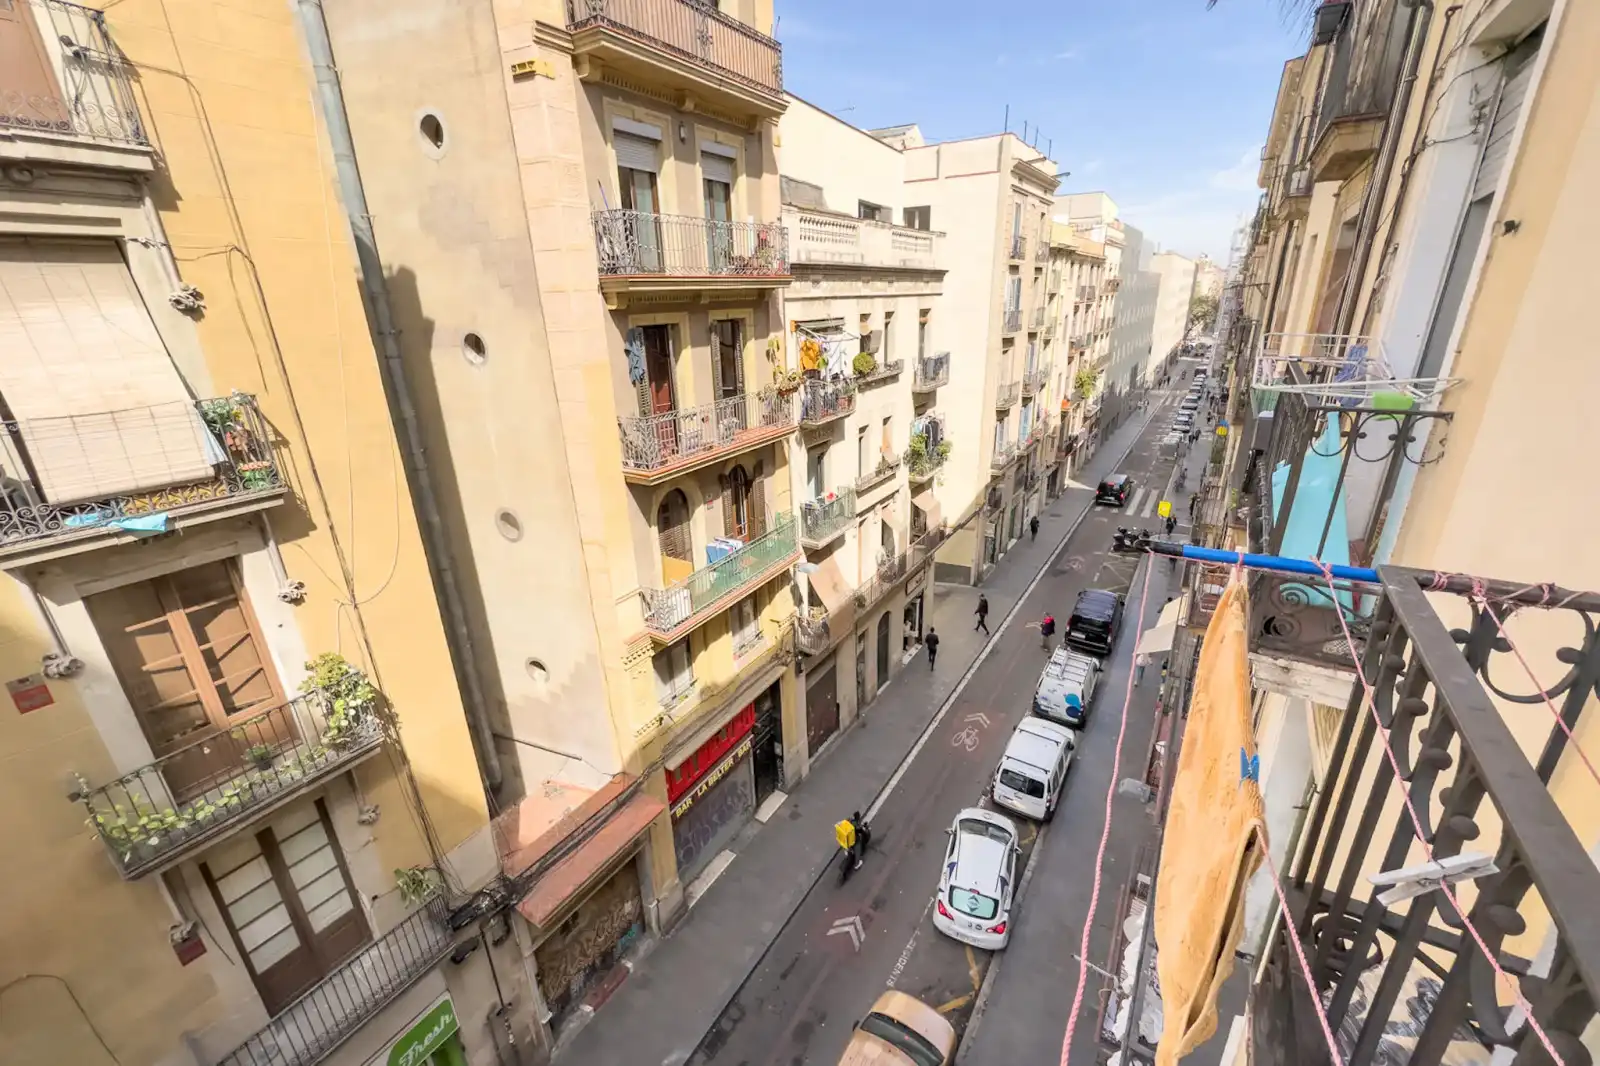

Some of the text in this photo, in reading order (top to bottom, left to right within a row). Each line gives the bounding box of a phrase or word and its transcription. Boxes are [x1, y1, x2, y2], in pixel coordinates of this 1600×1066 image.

[676, 797, 693, 817] BAR
[697, 783, 708, 797] LA
[738, 740, 751, 757] BAR
